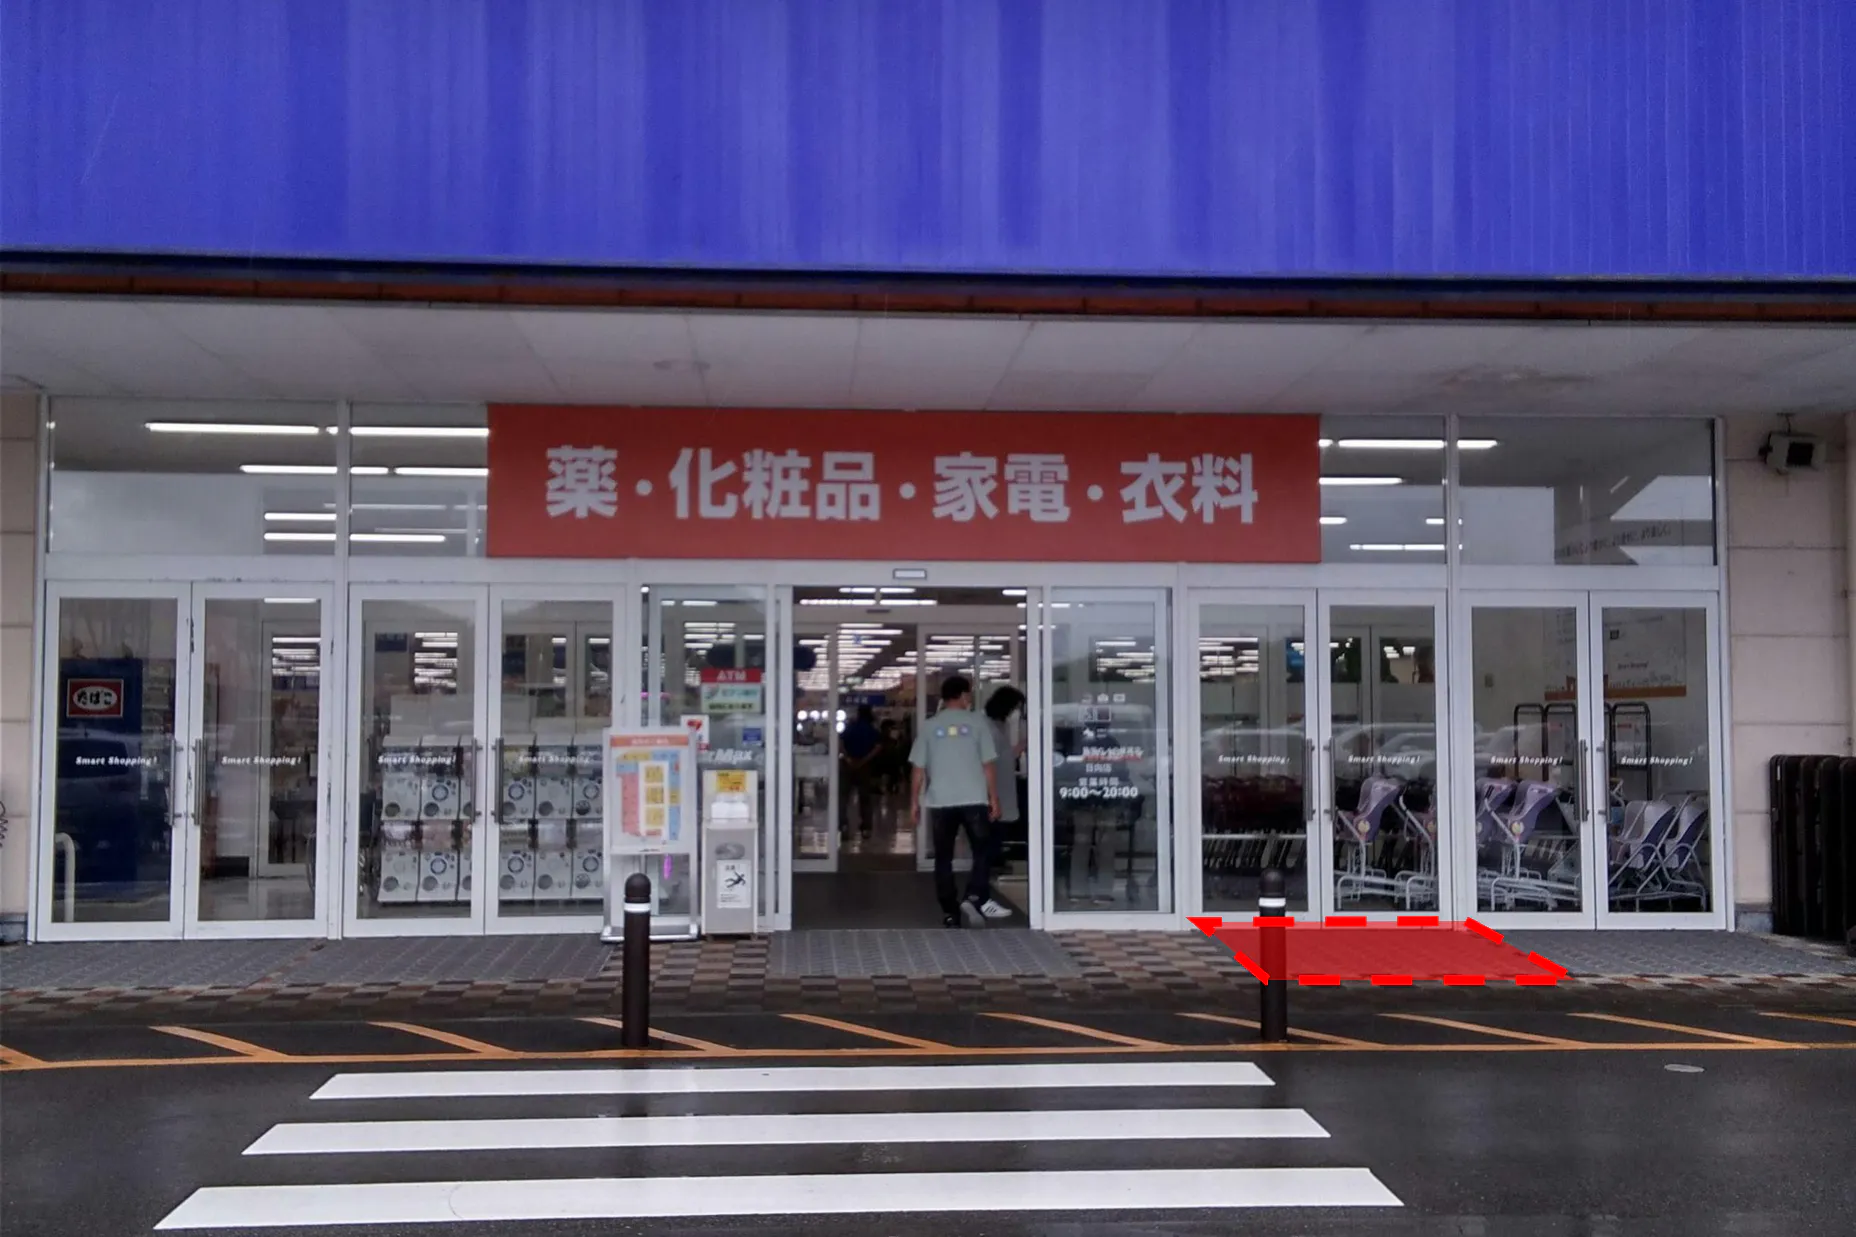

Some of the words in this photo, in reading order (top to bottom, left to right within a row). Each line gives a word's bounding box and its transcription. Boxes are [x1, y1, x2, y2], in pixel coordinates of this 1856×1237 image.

[545, 444, 1258, 525] 薬・化粧品・家電・衣料
[717, 669, 748, 681] ATM
[77, 689, 113, 705] たばこ
[75, 755, 105, 765] Smart
[108, 755, 158, 767] Shopping!
[221, 756, 250, 765] Smart
[253, 755, 301, 766] Shopping!
[377, 754, 407, 764] Smart
[1348, 755, 1374, 764] Smart
[1490, 755, 1517, 765] Smart
[1620, 755, 1648, 765] Smart
[1650, 755, 1694, 766] Shopping!
